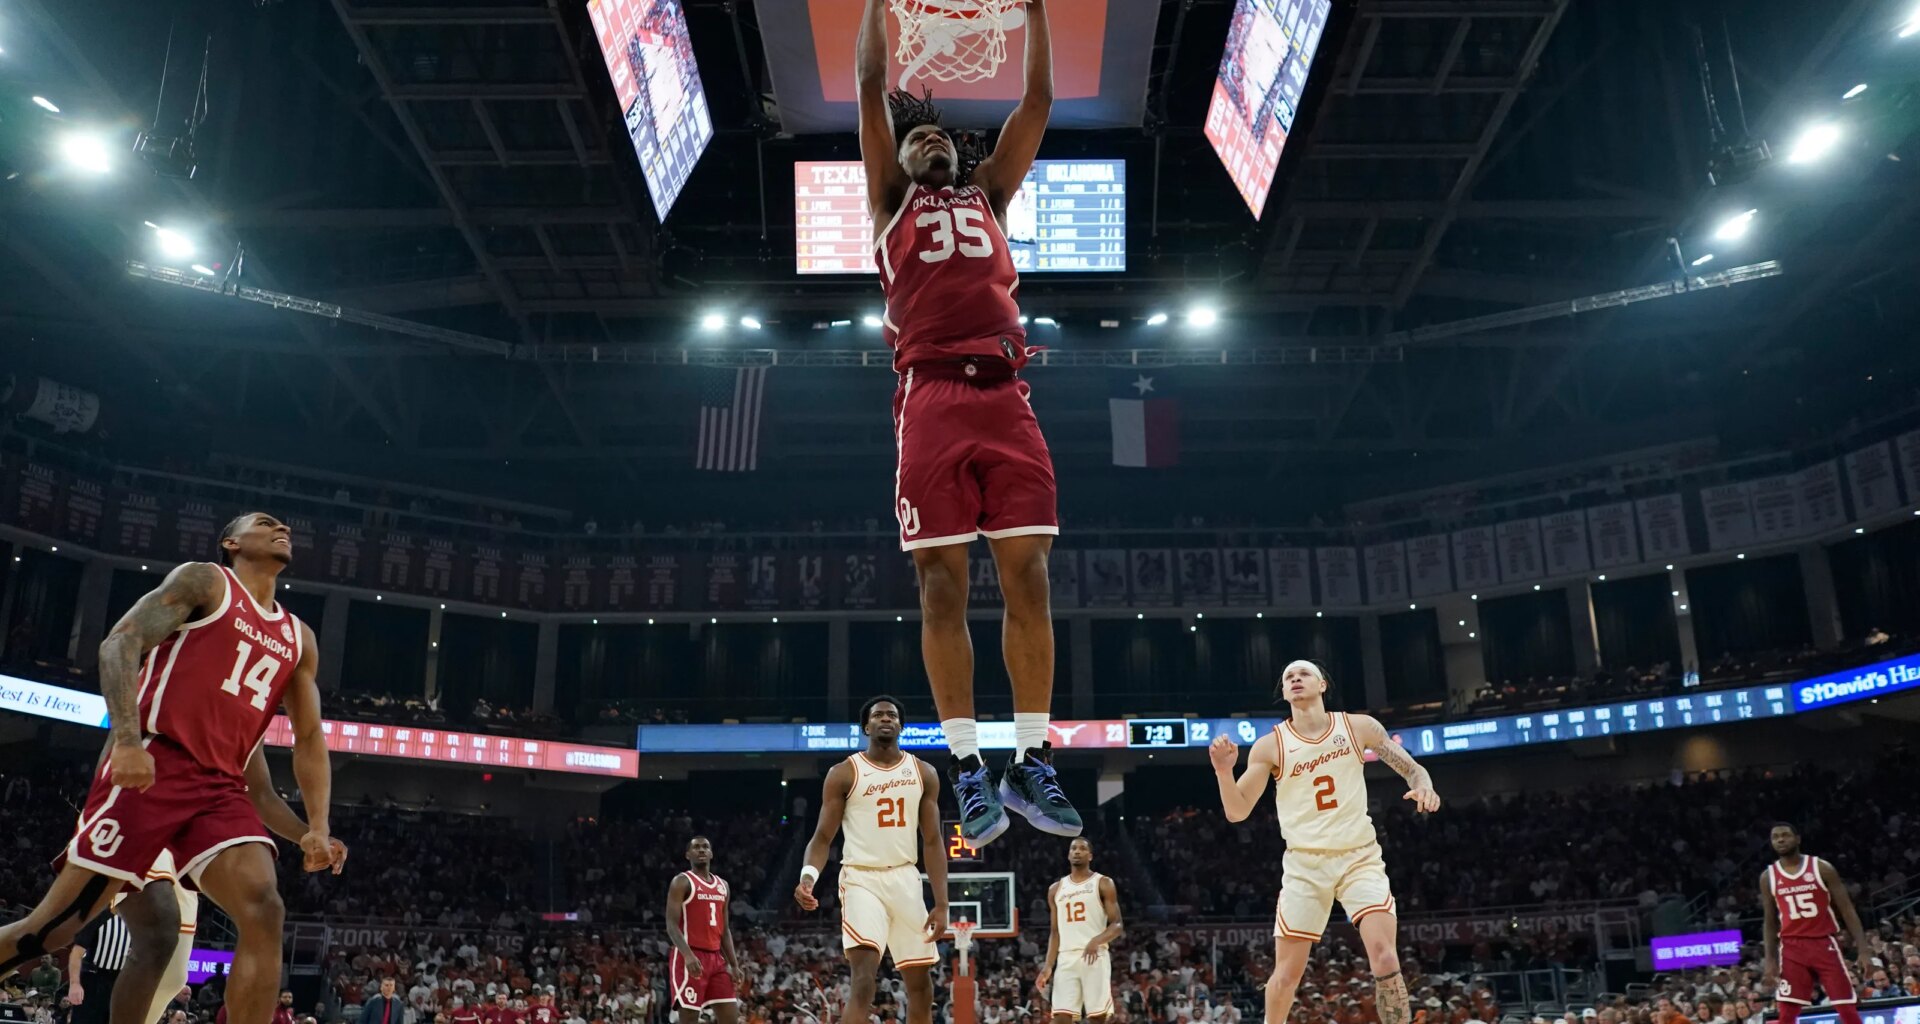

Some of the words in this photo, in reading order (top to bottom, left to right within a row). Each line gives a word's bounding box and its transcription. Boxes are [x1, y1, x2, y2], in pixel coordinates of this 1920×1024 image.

[811, 166, 866, 184] TEXAS
[1047, 164, 1115, 182] OKLAHOMA
[913, 195, 985, 211] OKLAHOMA
[915, 207, 993, 264] 35
[1010, 249, 1031, 269] 22
[900, 497, 921, 536] OU
[750, 555, 776, 585] 15
[234, 617, 293, 662] OKLAHOMA
[220, 639, 281, 712] 14
[27, 692, 41, 705] Is
[44, 695, 82, 714] Here.
[1676, 698, 1692, 711] STL
[1705, 695, 1723, 707] BLK
[1736, 692, 1749, 704] FT
[802, 726, 807, 737] 2
[808, 725, 826, 737] DUKE
[1106, 724, 1124, 742] 23
[1190, 723, 1209, 741] 22
[1237, 721, 1256, 743] OU
[1523, 731, 1529, 742] 1
[1629, 719, 1636, 731] 2
[1738, 705, 1752, 718] 1-2
[348, 739, 353, 750] 1
[374, 741, 379, 752] 1
[399, 743, 405, 754] 0
[425, 745, 431, 757] 0
[476, 750, 482, 761] 0
[396, 730, 410, 741] AST
[422, 732, 434, 743] FLS
[448, 735, 459, 746] STL
[473, 737, 486, 748] BLK
[500, 740, 508, 750] FT
[850, 737, 859, 748] 67
[1421, 730, 1434, 752] 0
[1289, 746, 1352, 778] Longhorns
[863, 778, 917, 798] Longhorns
[1313, 775, 1338, 812] 2
[876, 797, 906, 828] 21
[88, 818, 125, 858] OU
[697, 892, 726, 903] OKLAHOMA
[1777, 883, 1818, 896] OKLAHOMA
[709, 902, 718, 927] 1
[1065, 901, 1086, 923] 12
[1784, 892, 1818, 920] 15
[1674, 944, 1712, 958] NEXEN
[1712, 941, 1740, 955] TIRE
[201, 961, 231, 974] NEE
[685, 985, 698, 1004] OU
[1778, 978, 1792, 996] OU
